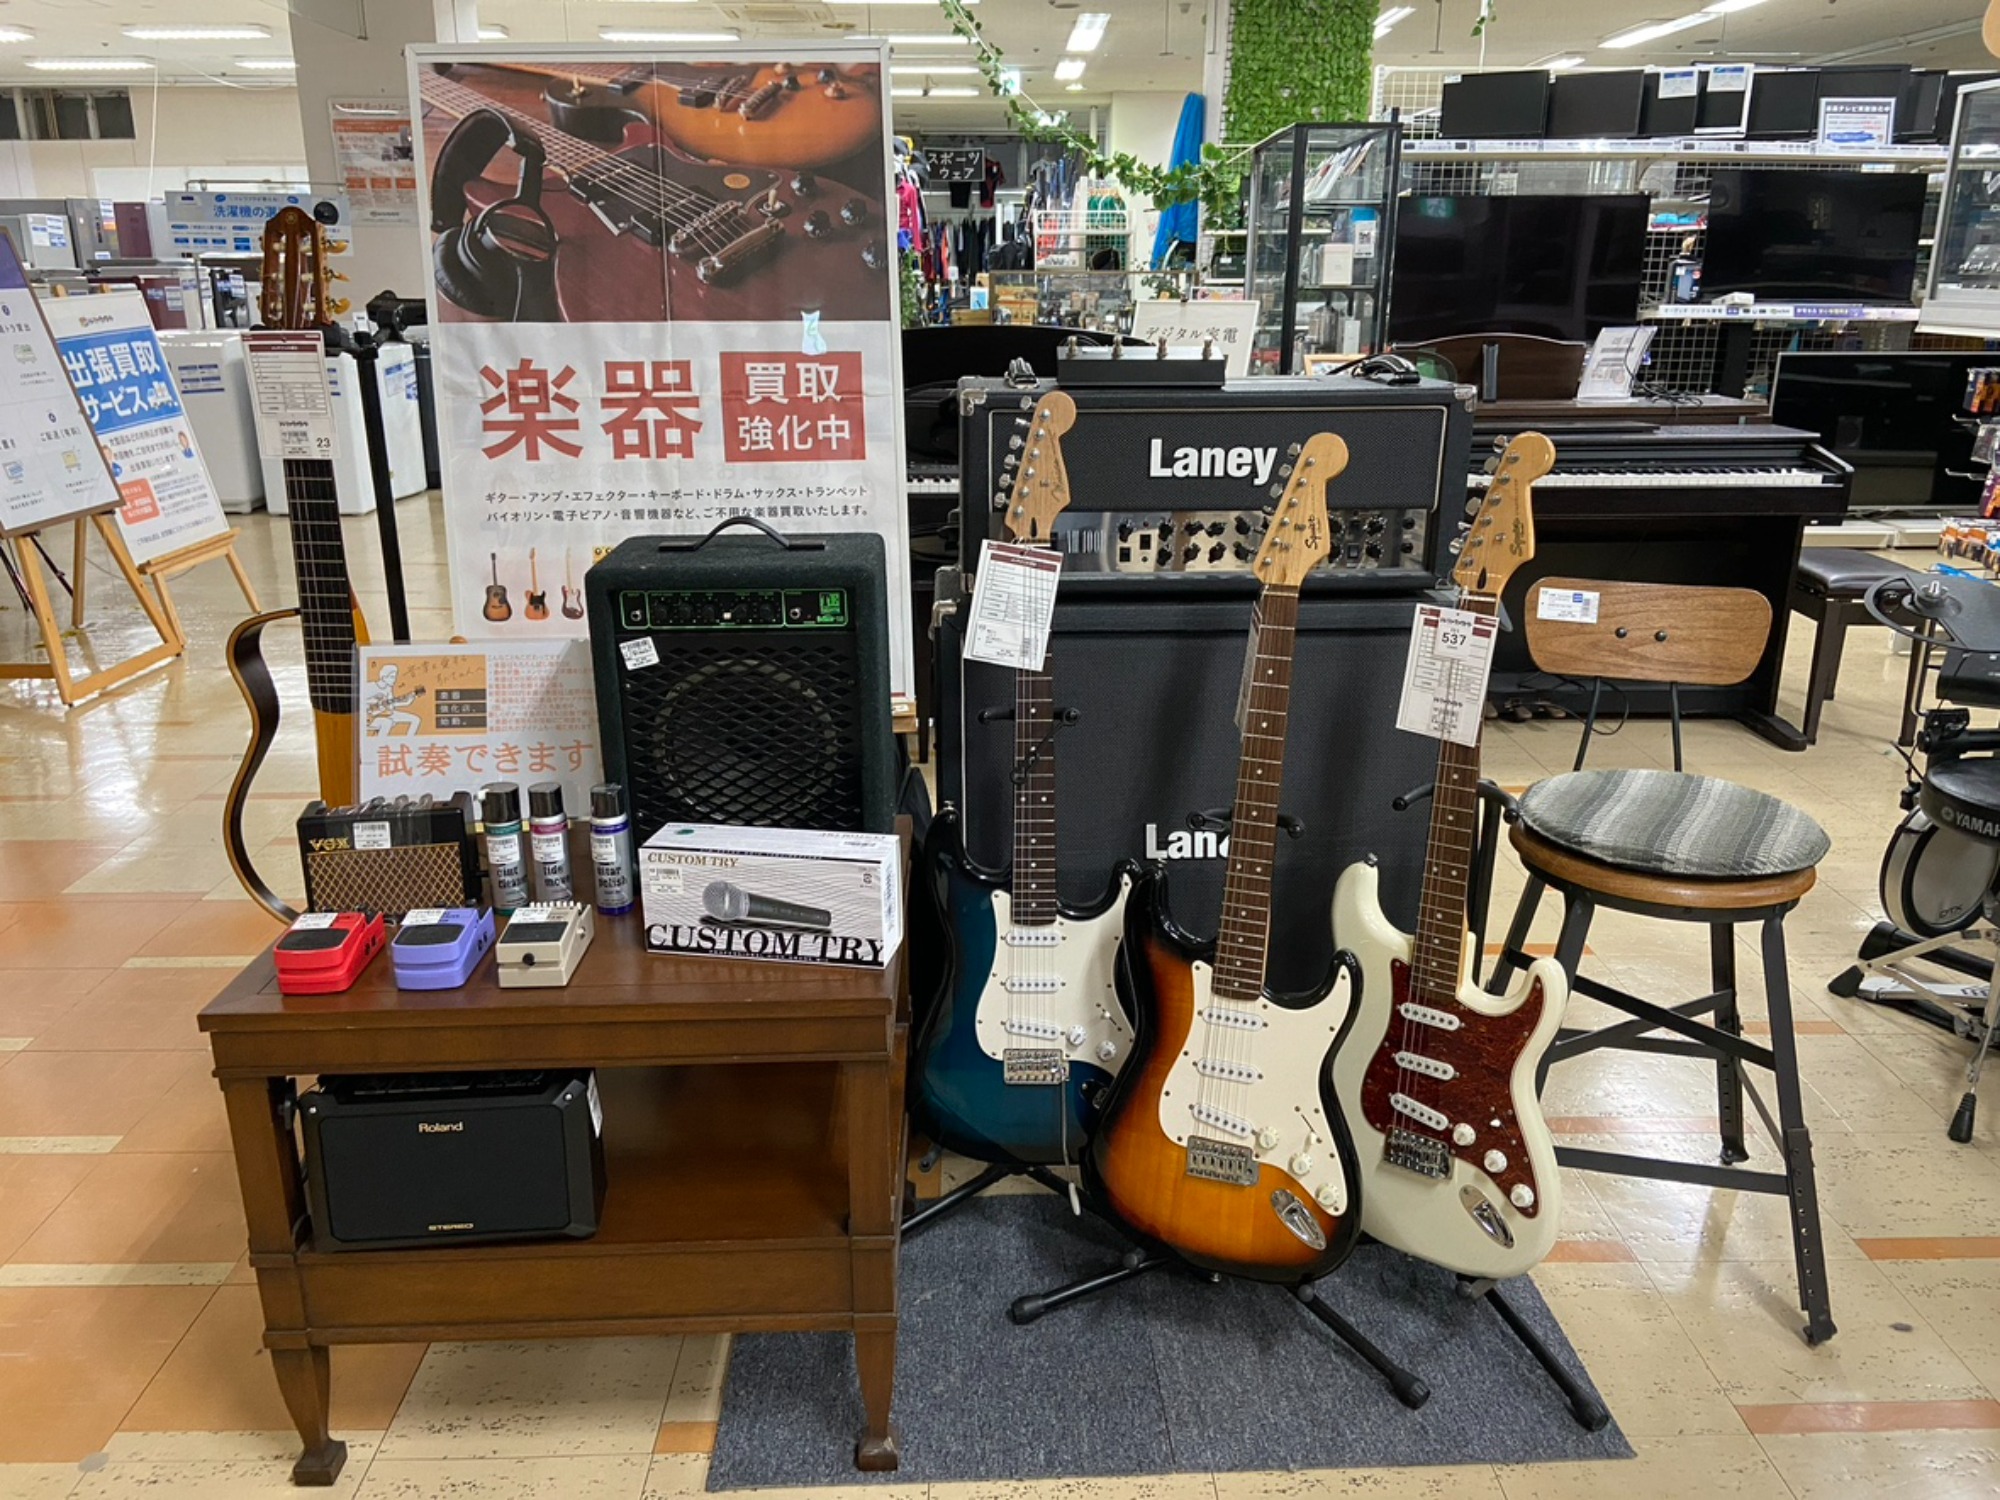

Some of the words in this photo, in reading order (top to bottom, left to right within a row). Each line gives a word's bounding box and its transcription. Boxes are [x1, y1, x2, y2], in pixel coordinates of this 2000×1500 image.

[926, 153, 980, 165] スポーツ
[938, 167, 975, 179] ウェア
[213, 205, 280, 218] 洗濯機の選
[1145, 326, 1239, 343] デジタル家電
[62, 340, 161, 388] 出張買取
[744, 361, 843, 405] 買取
[80, 386, 148, 424] サービス
[478, 357, 703, 462] 楽器
[737, 413, 851, 452] 強化中
[316, 437, 331, 448] 23
[1149, 437, 1279, 486] Laney
[1441, 632, 1467, 646] 537
[376, 739, 595, 778] 試奏できます
[308, 837, 350, 853] VOX
[1146, 823, 1230, 860] Lan
[647, 851, 707, 867] CUSTOM
[709, 856, 739, 869] TRY
[645, 923, 803, 958] CUSTOM
[811, 934, 885, 964] TRY
[418, 1121, 464, 1134] Roland
[428, 1223, 474, 1232] STEREO
